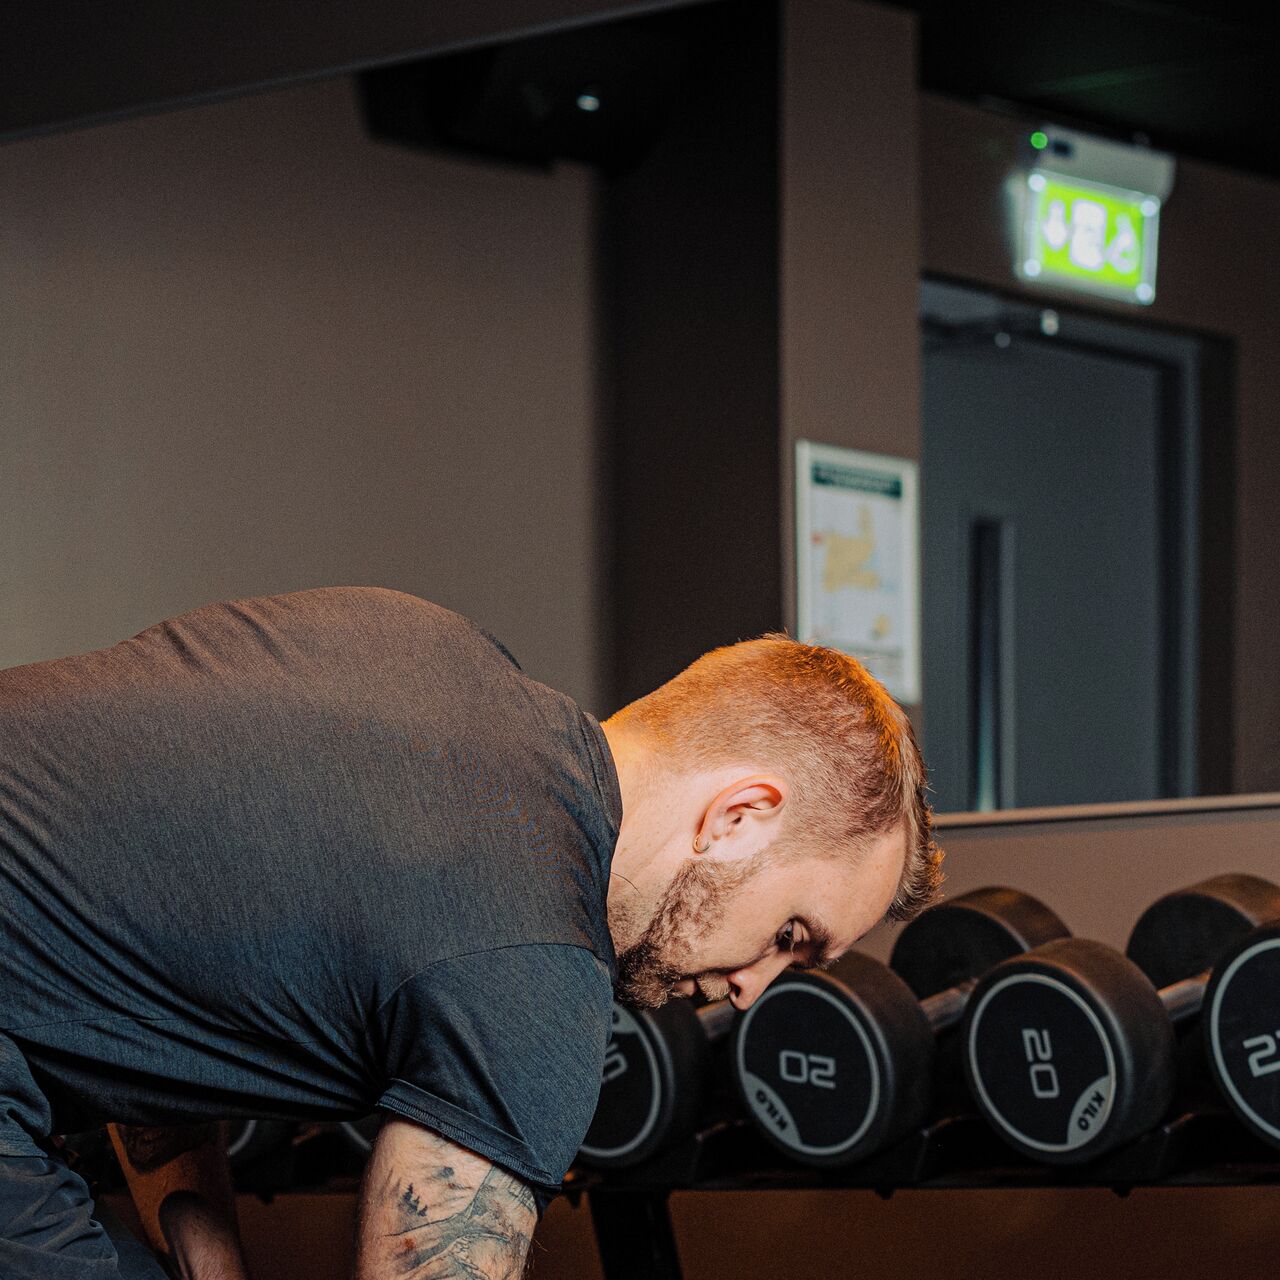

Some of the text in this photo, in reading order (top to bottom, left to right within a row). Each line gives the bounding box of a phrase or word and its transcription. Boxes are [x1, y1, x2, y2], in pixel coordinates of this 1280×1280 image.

[779, 1050, 836, 1089] 20
[1022, 1028, 1060, 1099] 20
[755, 1089, 788, 1131] KILO
[1077, 1091, 1105, 1132] KILO
